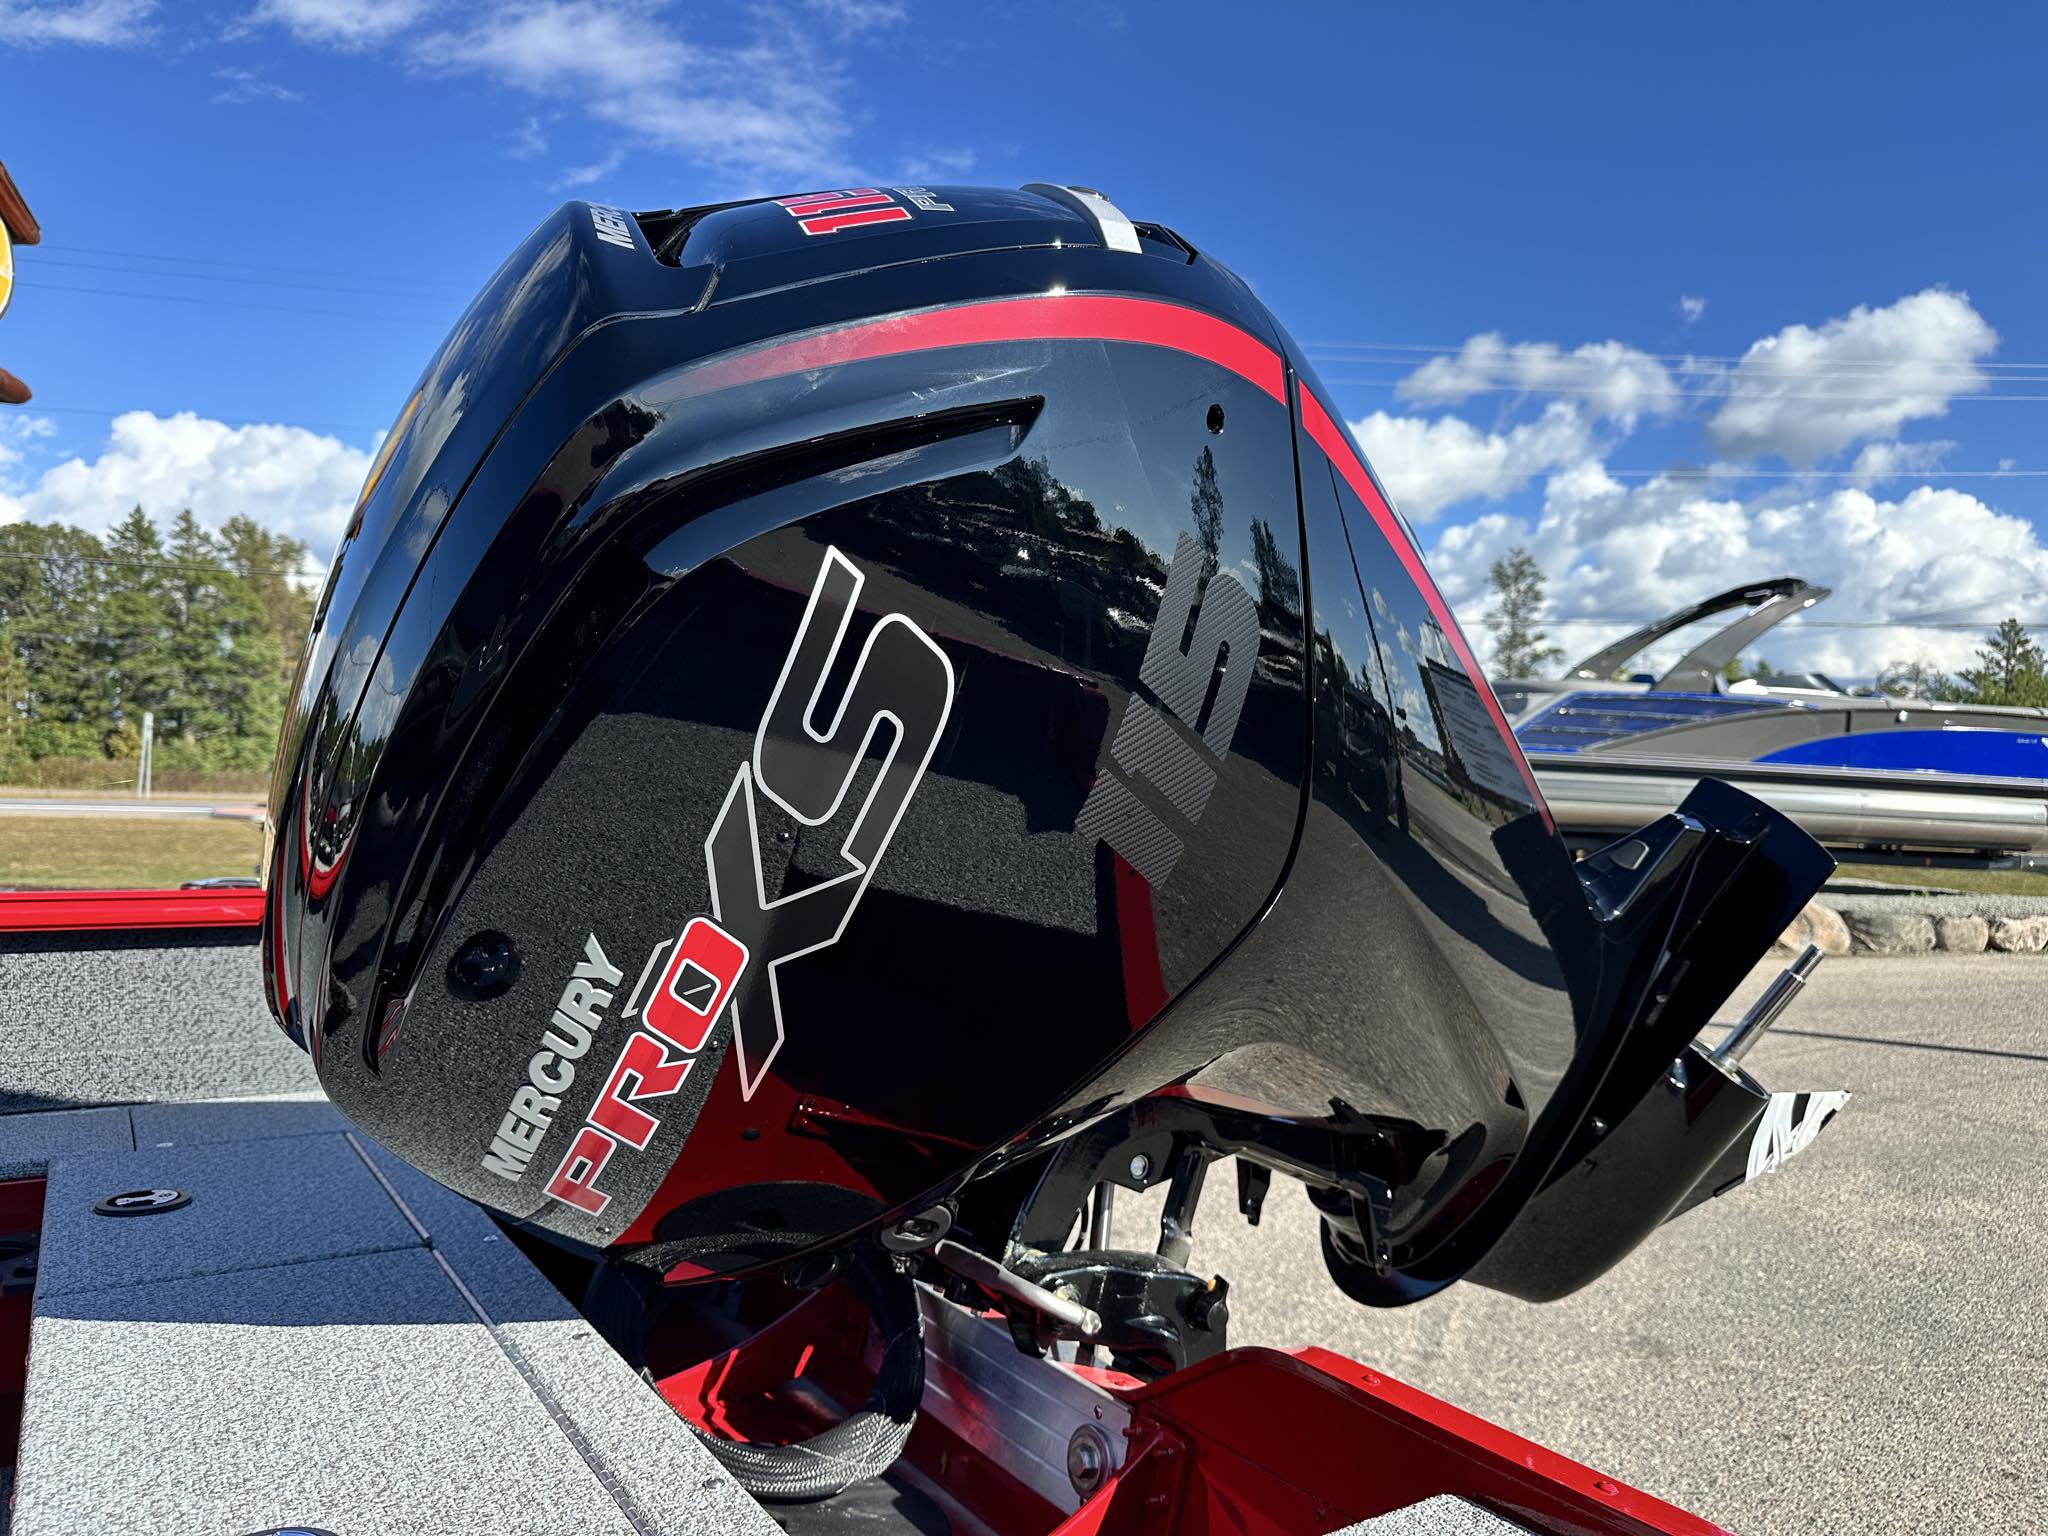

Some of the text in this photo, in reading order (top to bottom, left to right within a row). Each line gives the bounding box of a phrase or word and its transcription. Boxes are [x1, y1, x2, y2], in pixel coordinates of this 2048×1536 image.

[541, 544, 955, 1217] PRO XS
[1074, 528, 1261, 890] 115
[481, 933, 624, 1182] MERCURY
